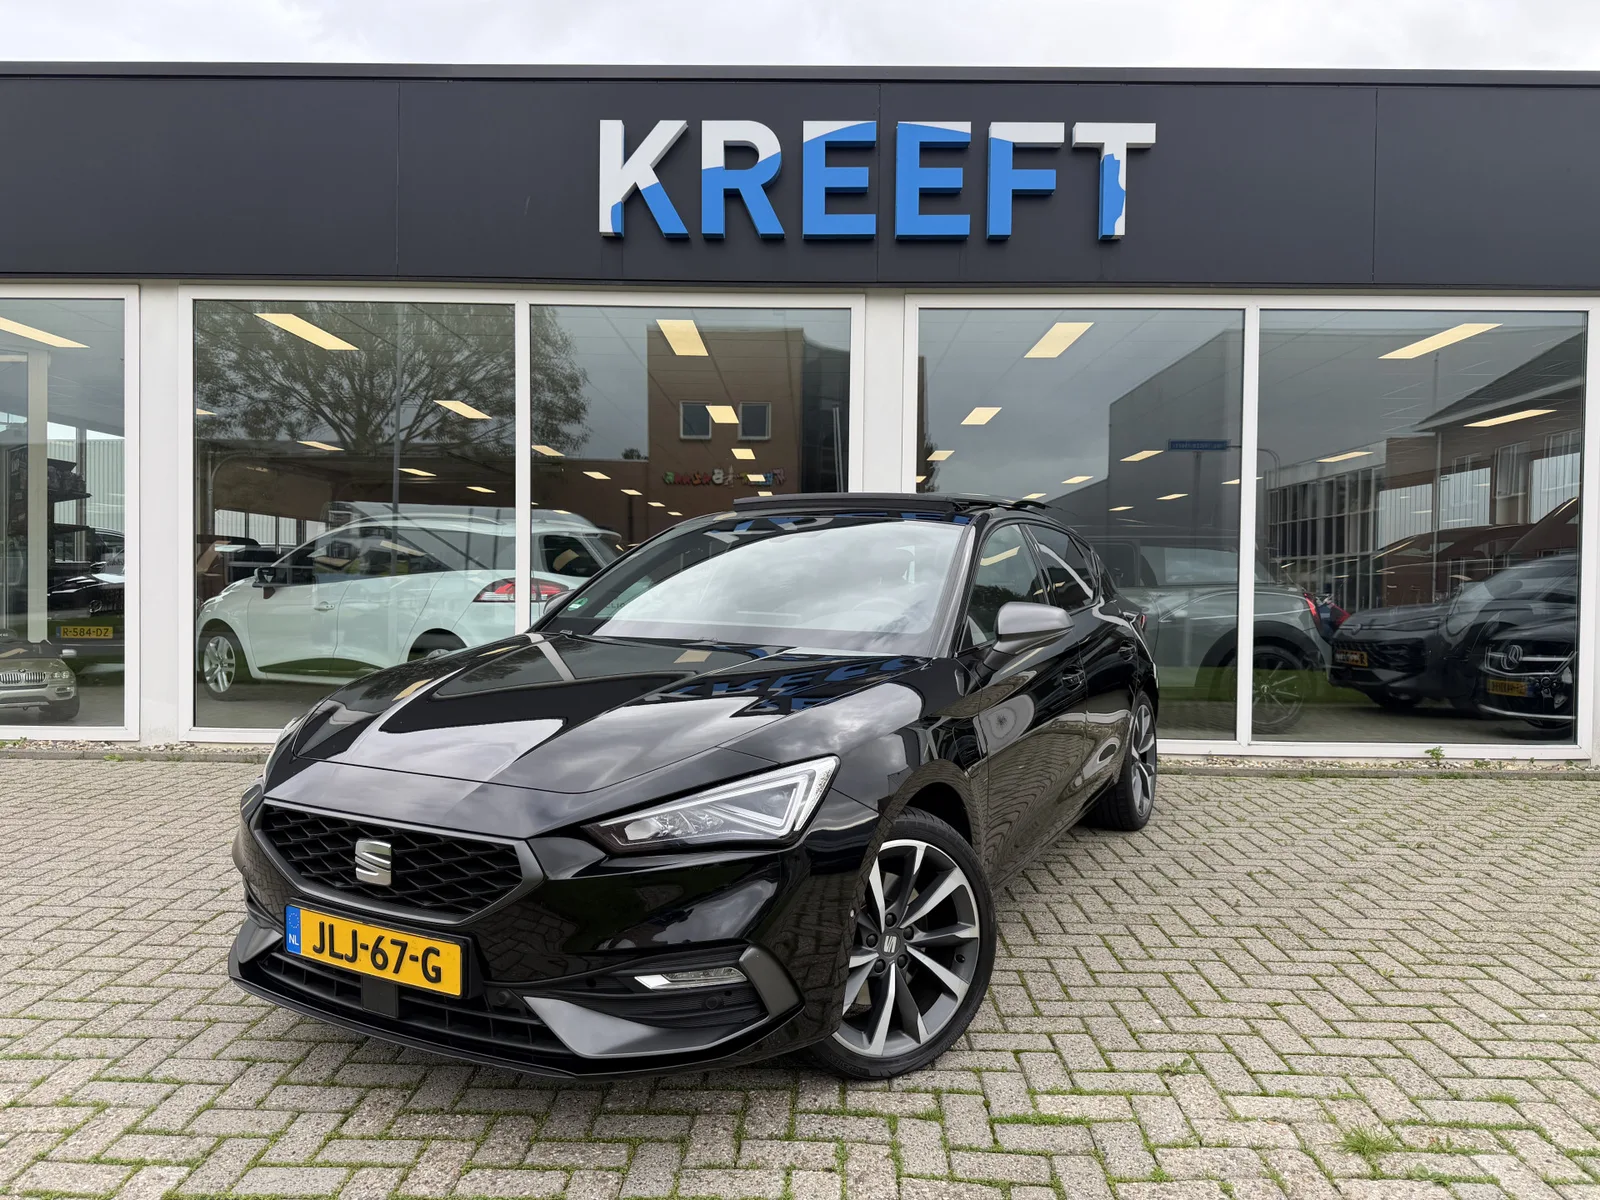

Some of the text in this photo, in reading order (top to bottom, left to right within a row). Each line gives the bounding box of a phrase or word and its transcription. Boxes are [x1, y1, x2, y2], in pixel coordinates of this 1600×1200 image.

[599, 119, 1156, 239] KREEFT
[62, 627, 109, 637] R-584-DZ
[289, 933, 300, 946] NL
[312, 920, 442, 984] JLJ-67-G
